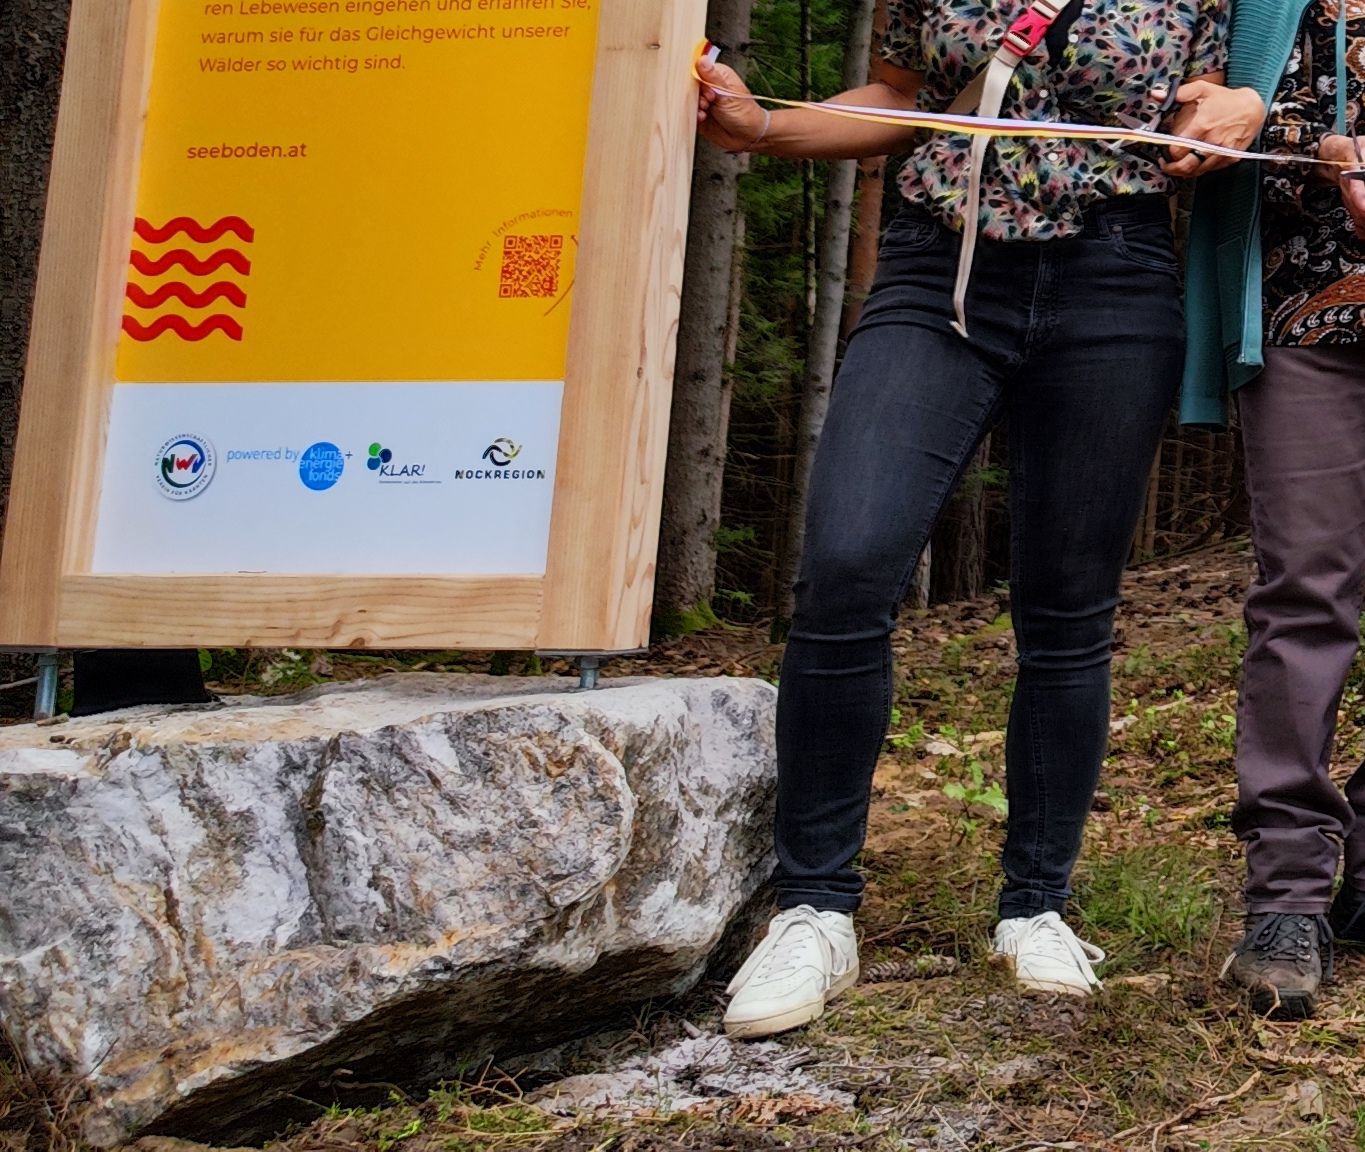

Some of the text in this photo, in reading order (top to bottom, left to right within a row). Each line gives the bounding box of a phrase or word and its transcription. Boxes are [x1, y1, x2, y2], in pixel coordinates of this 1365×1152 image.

[204, 3, 234, 16] ren
[239, 0, 340, 16] Lebewesen
[200, 23, 571, 45] warum sie für das Gleichgewicht unserer
[199, 54, 406, 74] Wälder so wichtig sind.
[186, 141, 307, 160] seeboden.at
[474, 208, 573, 271] Mehr Informationen
[226, 448, 300, 463] powered by
[309, 448, 342, 460] klima
[299, 459, 344, 472] energie
[379, 464, 426, 477] KLAR!
[308, 469, 341, 481] fonds
[454, 469, 546, 480] NOCKREGION
